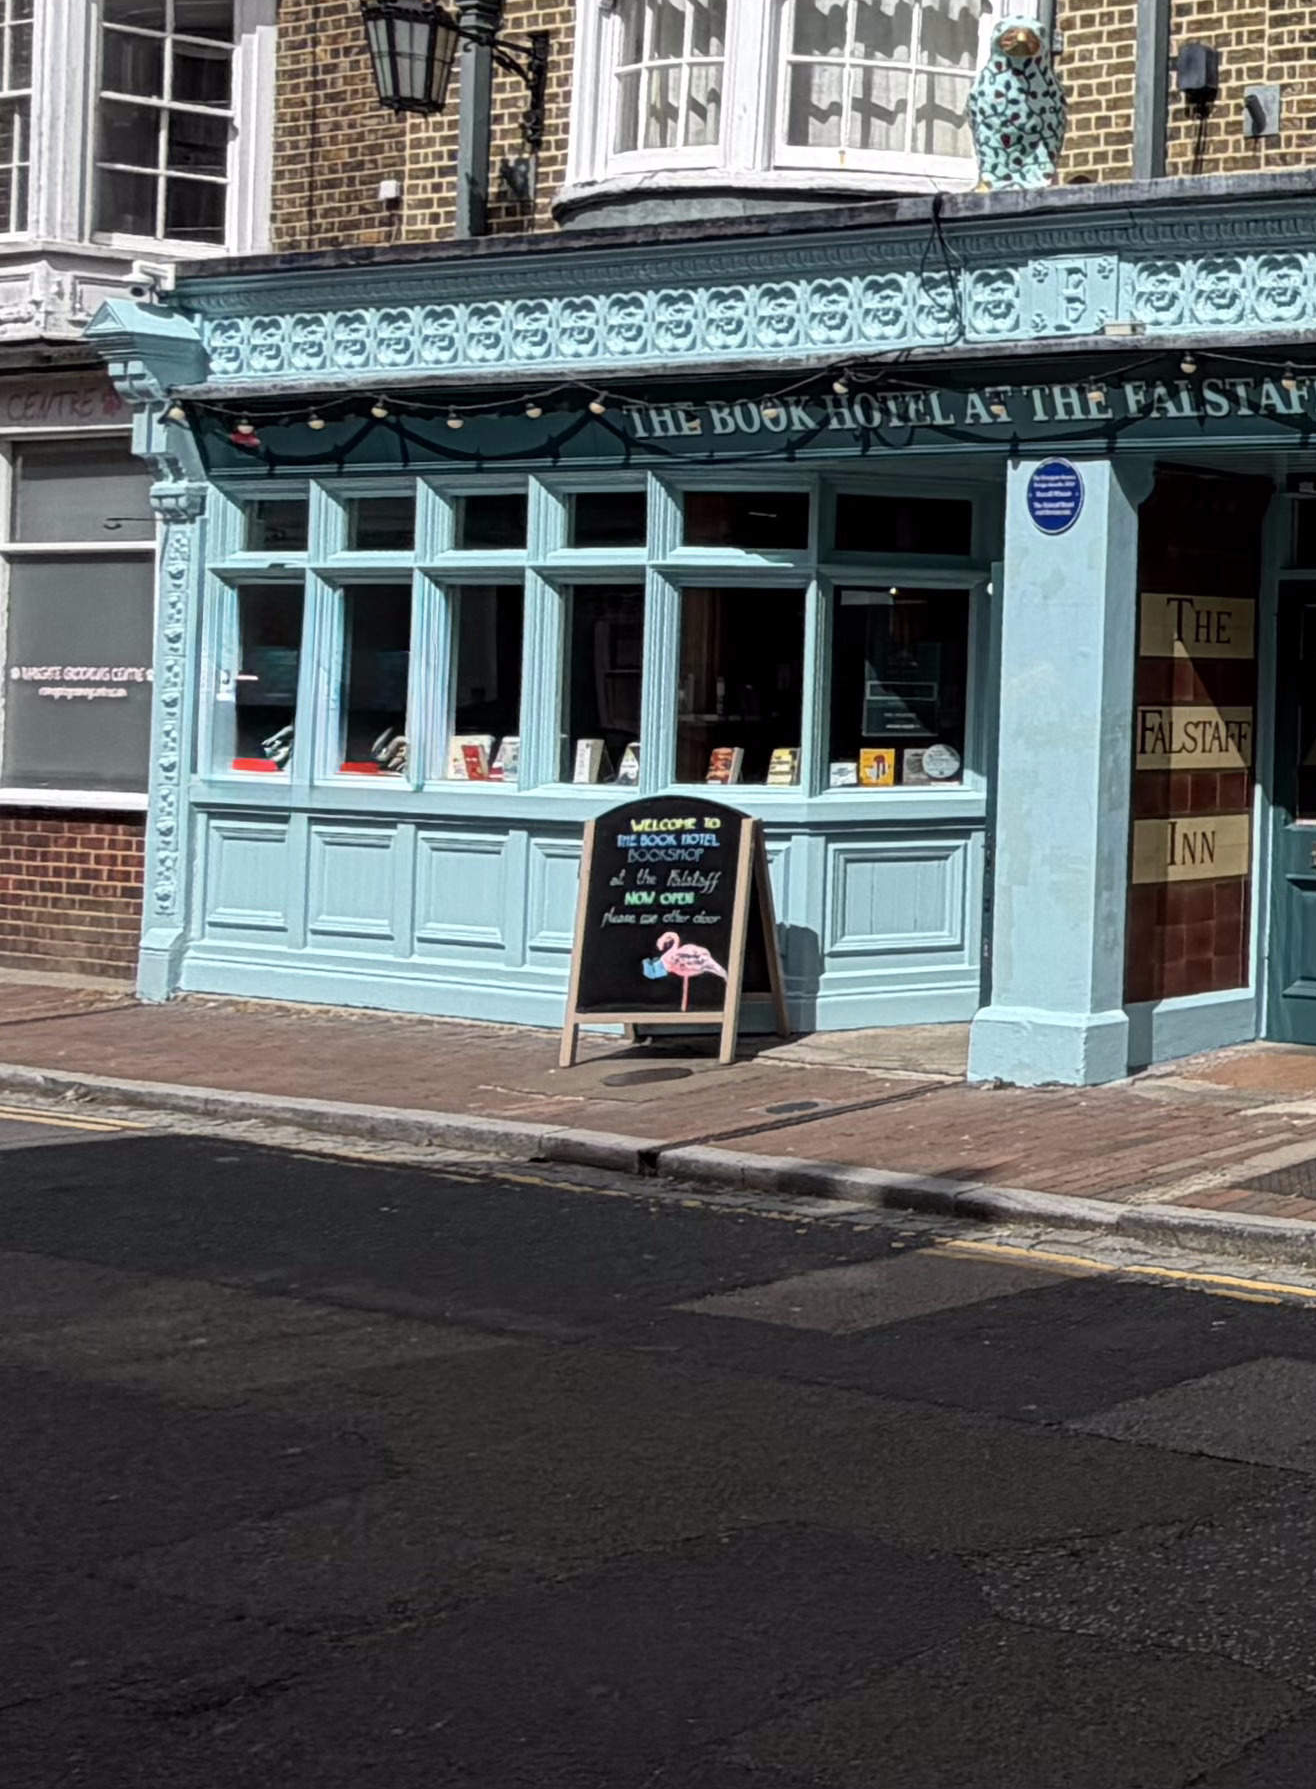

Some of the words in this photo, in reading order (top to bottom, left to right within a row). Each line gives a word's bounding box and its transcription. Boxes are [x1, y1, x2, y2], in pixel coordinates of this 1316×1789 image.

[8, 388, 97, 421] CENTRE
[622, 401, 703, 438] THE
[705, 394, 820, 435] BOOK
[821, 389, 955, 431] HOTEL
[965, 386, 1012, 425] AT
[1022, 382, 1114, 423] THE
[1167, 597, 1232, 644] THE
[1139, 709, 1250, 755] FALSTAFF
[631, 818, 697, 832] WELCOME
[704, 817, 721, 829] TO
[617, 834, 638, 848] THE
[640, 834, 677, 846] BOOK
[681, 833, 721, 846] HOTEL
[1167, 821, 1217, 866] INN
[628, 848, 704, 863] BOOKSHOP
[609, 868, 626, 886] at
[636, 868, 657, 885] the
[667, 869, 722, 894] Falstaff
[624, 890, 656, 906] NOW
[660, 891, 695, 905] OPEN
